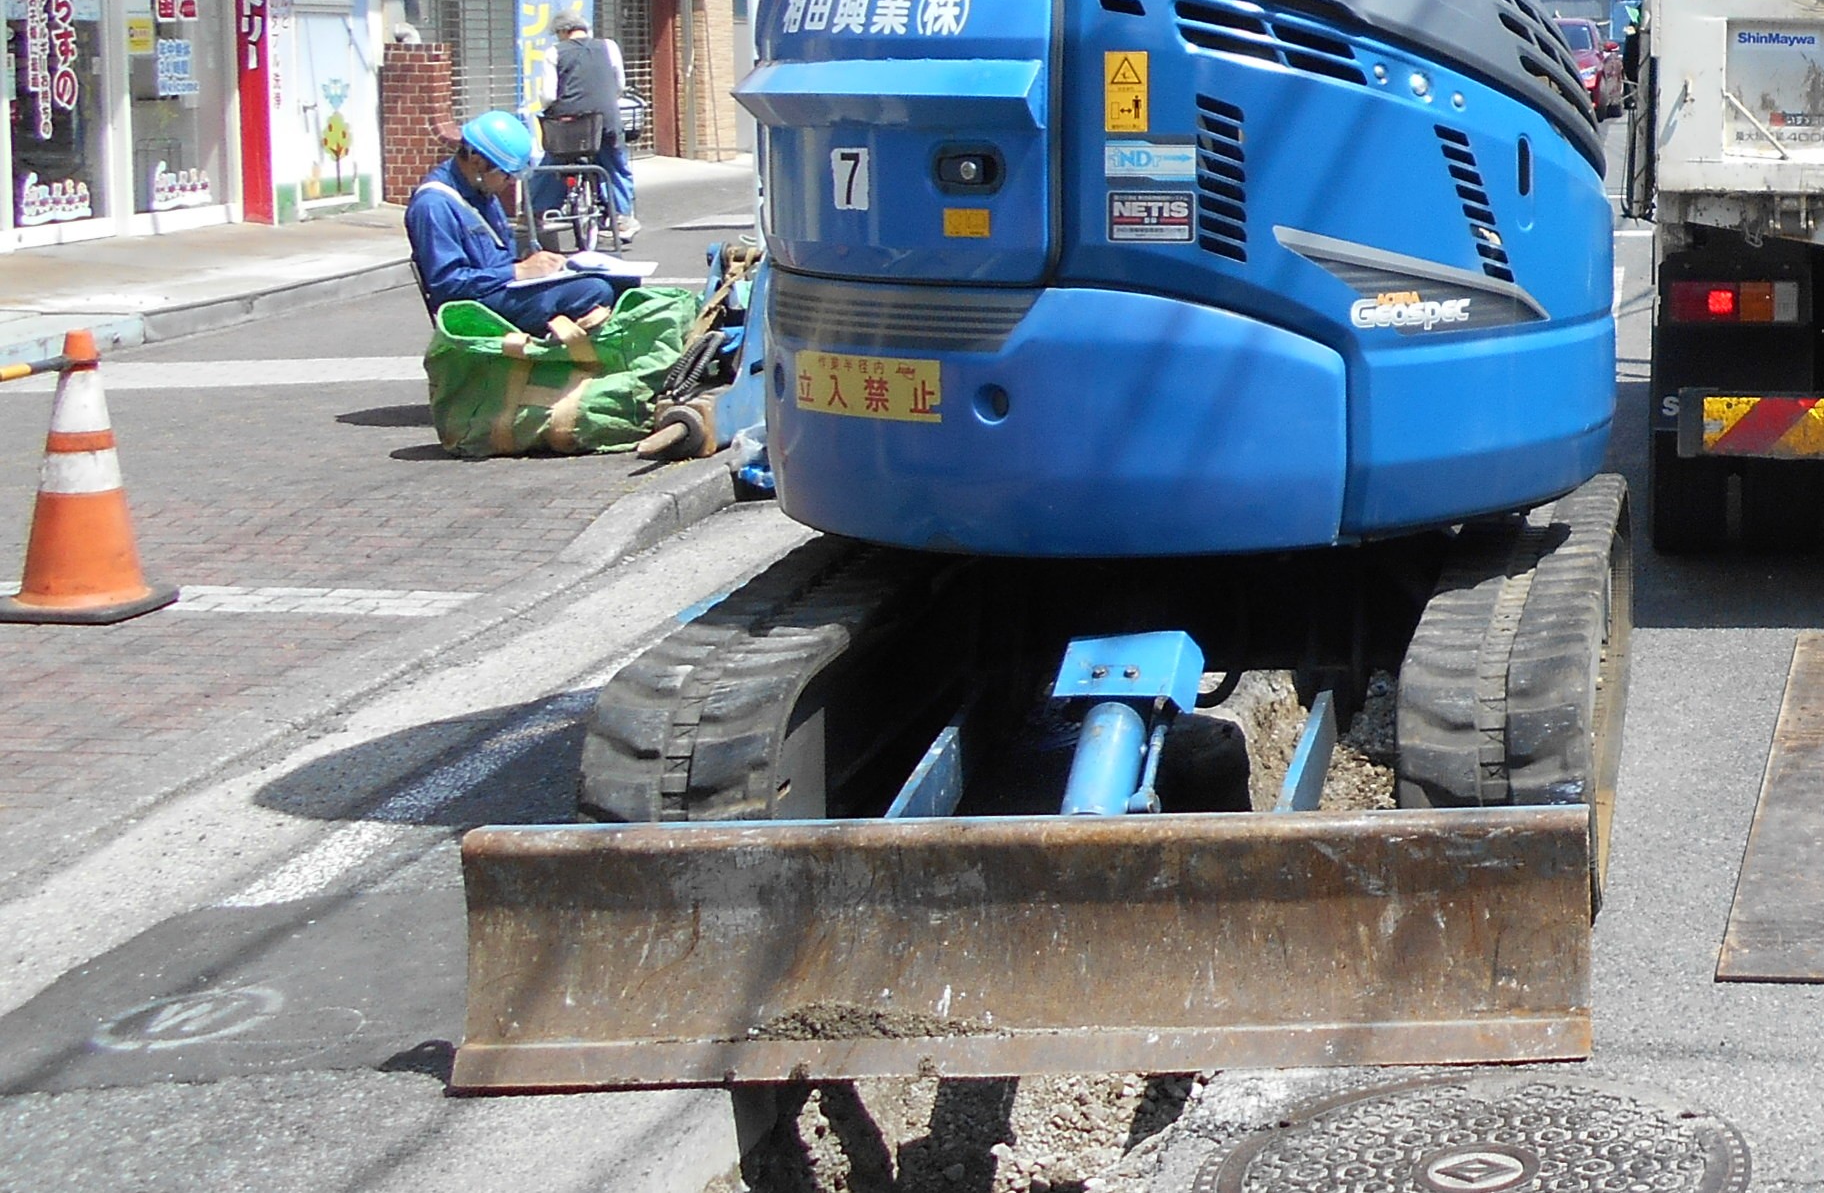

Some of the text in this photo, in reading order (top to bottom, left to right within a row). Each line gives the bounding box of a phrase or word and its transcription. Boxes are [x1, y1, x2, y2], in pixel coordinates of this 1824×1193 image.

[1737, 32, 1815, 47] ShinMaywa
[841, 152, 860, 205] 7
[1113, 201, 1189, 218] NETIS
[818, 356, 886, 375] 作業半径内
[798, 369, 936, 415] 立入禁止
